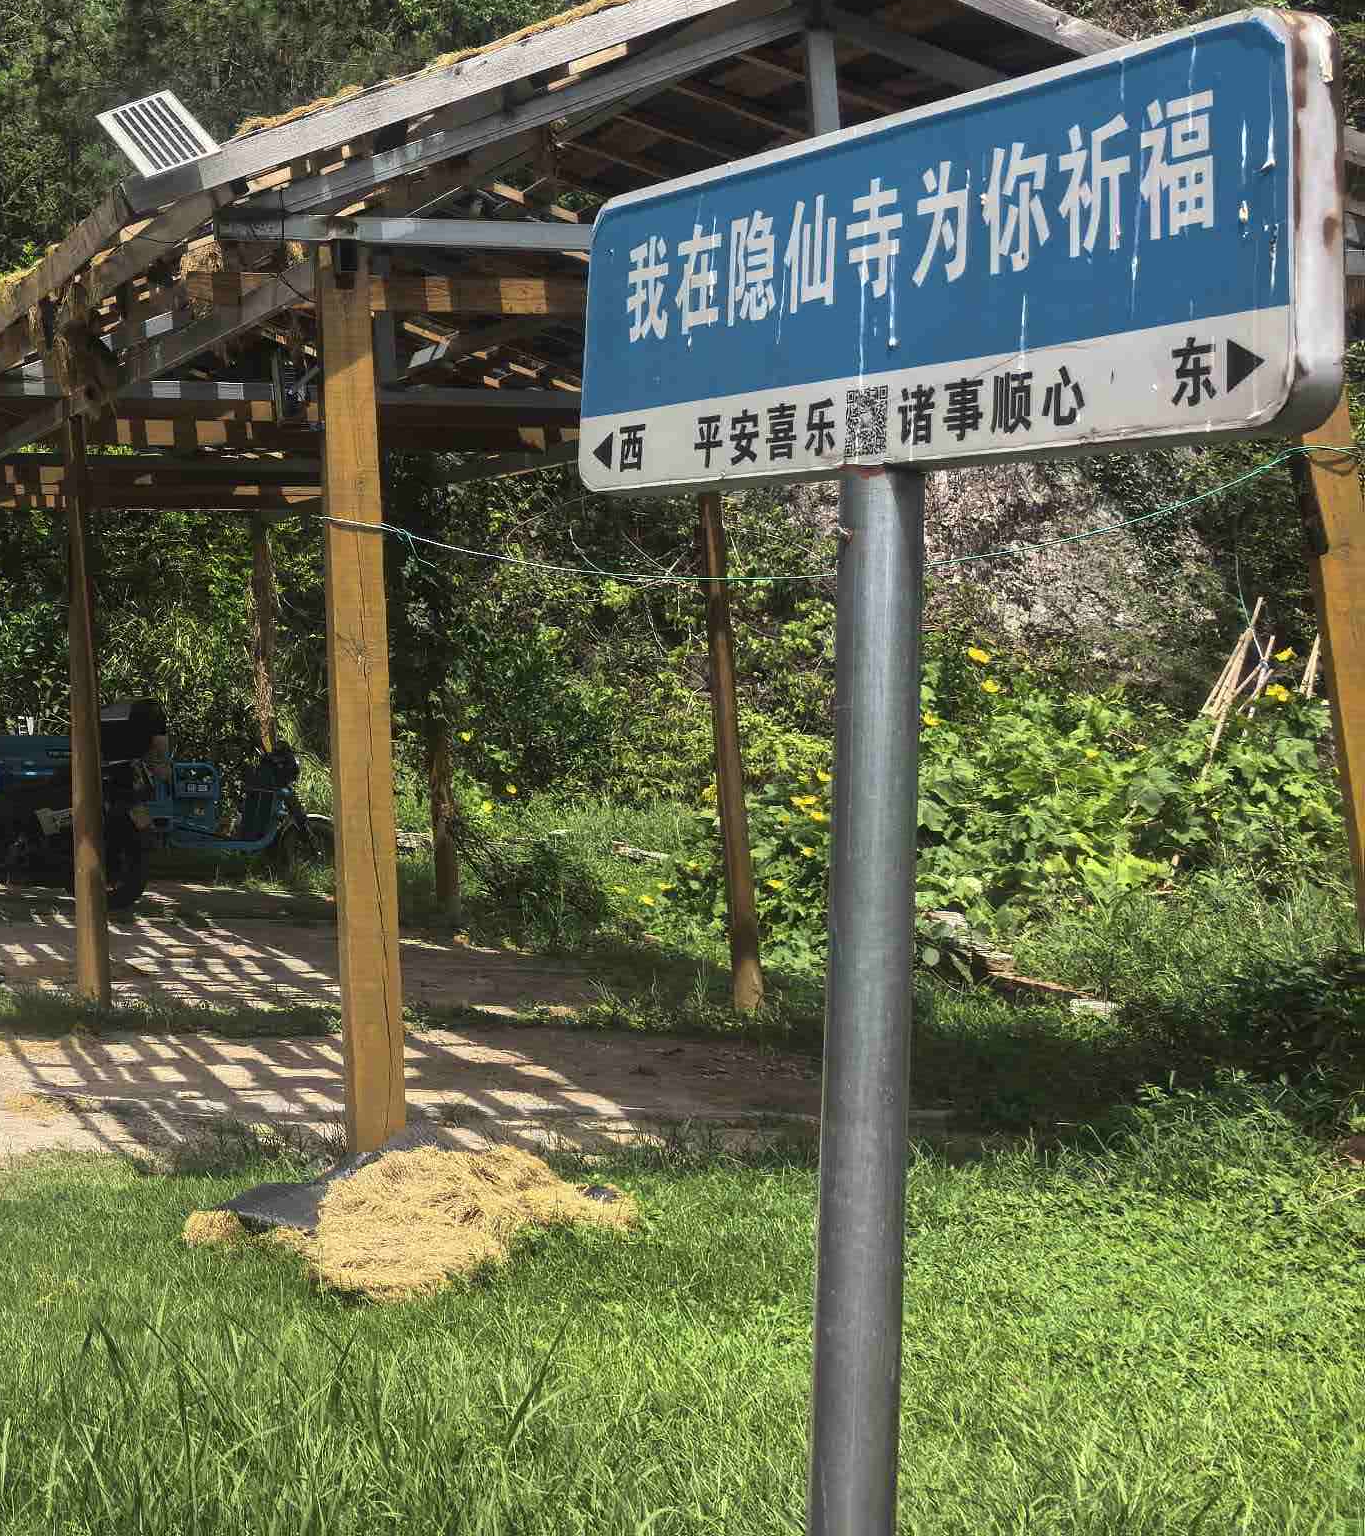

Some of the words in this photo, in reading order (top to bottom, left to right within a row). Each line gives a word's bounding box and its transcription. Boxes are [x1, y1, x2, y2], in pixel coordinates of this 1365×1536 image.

[626, 89, 1214, 343] 我在隐仙寺为你祈福
[619, 424, 646, 472] 西
[694, 398, 836, 468] 平安喜乐
[897, 366, 1085, 445] 诸事顺心
[1171, 336, 1217, 407] 东
